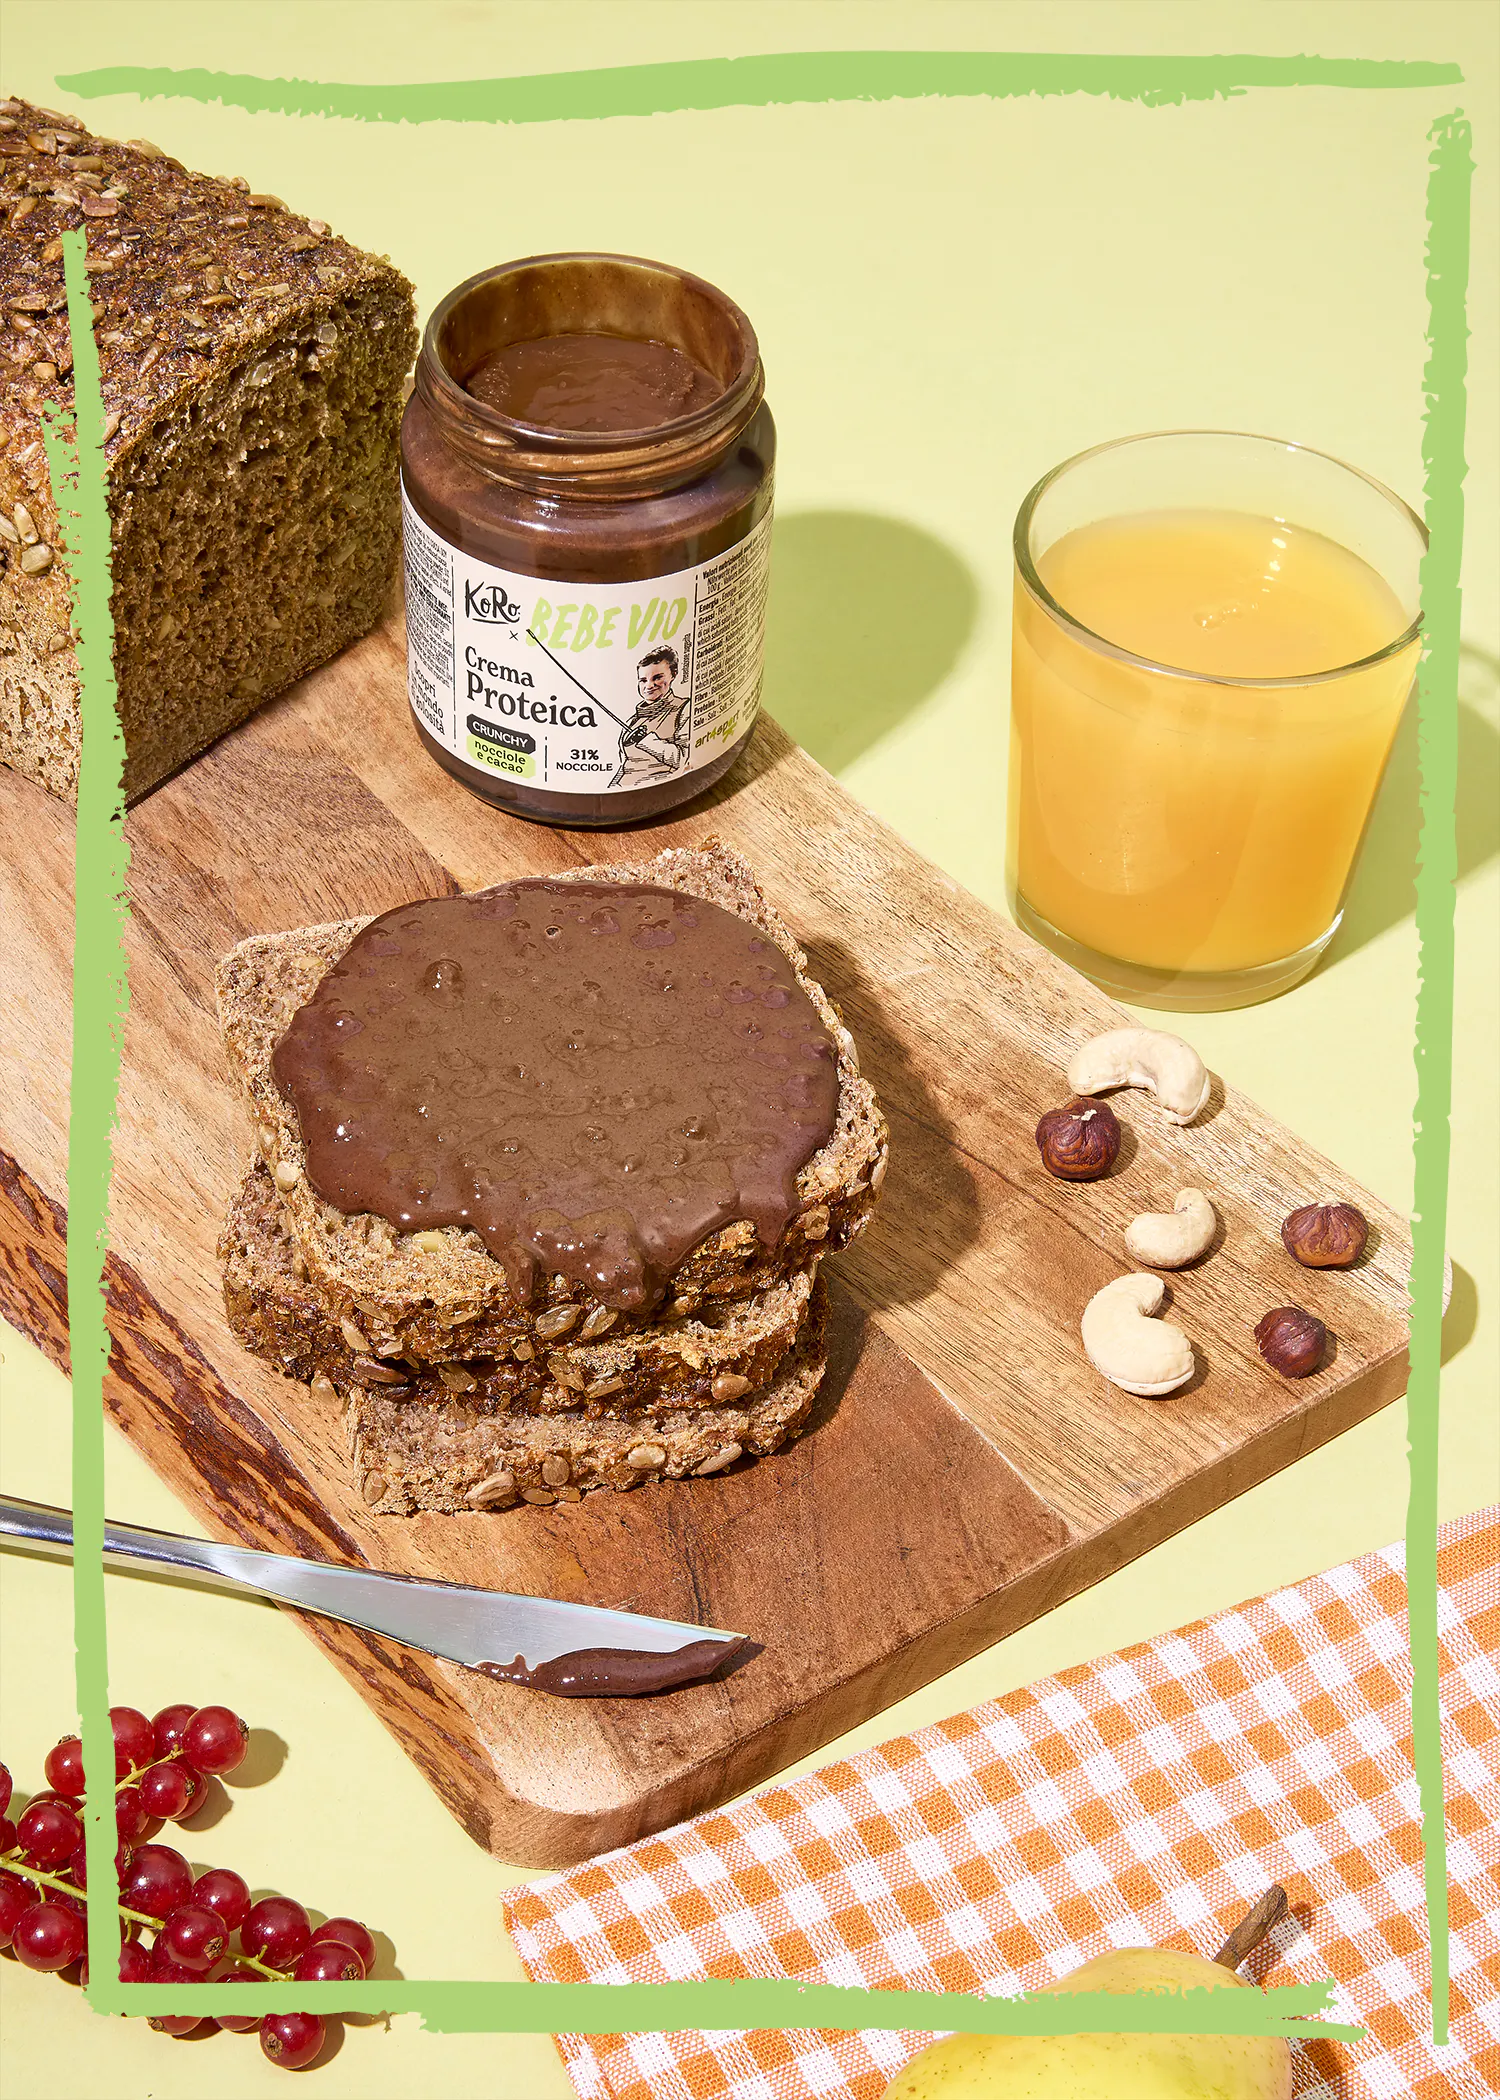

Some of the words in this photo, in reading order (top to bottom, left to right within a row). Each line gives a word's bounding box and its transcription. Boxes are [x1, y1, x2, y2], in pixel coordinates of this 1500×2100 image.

[464, 578, 521, 623] KoRo
[699, 598, 719, 613] Energia
[526, 596, 623, 653] BEBE
[627, 596, 688, 650] VIO
[698, 610, 715, 626] Grassi
[464, 645, 536, 689] Crema
[466, 669, 598, 728] Proteica
[694, 691, 708, 703] Fibre
[694, 699, 716, 716] Proteine
[693, 717, 705, 728] Sale
[472, 720, 529, 748] CRUNCHY
[474, 740, 526, 765] nocciole
[476, 751, 484, 760] e
[487, 754, 524, 774] cacao
[570, 749, 600, 761] 31%
[556, 762, 613, 772] NOCCIOLE
